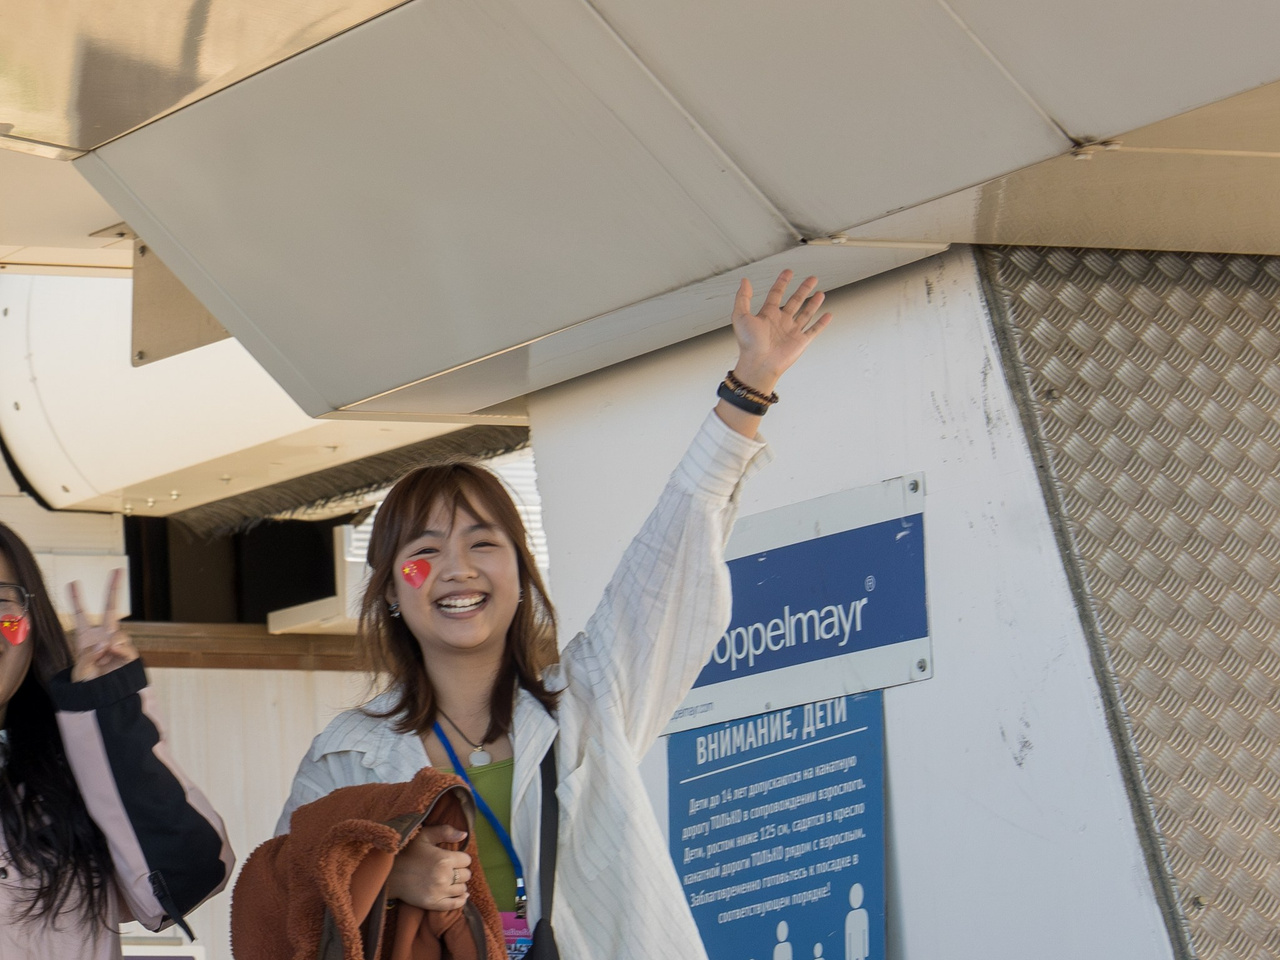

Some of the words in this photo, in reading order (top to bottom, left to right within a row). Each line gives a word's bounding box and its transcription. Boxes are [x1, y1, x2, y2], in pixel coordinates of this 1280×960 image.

[705, 597, 868, 672] oppelmayr
[696, 708, 797, 766] ВНИМАНИЕ,
[802, 696, 848, 740] ДЕТИ
[688, 798, 709, 816] Дети
[709, 795, 721, 810] до
[721, 788, 732, 804] 14
[733, 786, 748, 801] лет
[803, 767, 814, 781] на
[815, 755, 858, 777] канатную
[681, 821, 710, 841] дорогу
[710, 808, 742, 830] ТОЛЬКО
[706, 838, 735, 859] ростом
[735, 831, 759, 848] ниже
[760, 823, 776, 841] 125
[833, 802, 865, 823] кресло
[683, 862, 720, 886] канатной
[751, 845, 784, 867] ТОЛЬКО
[784, 841, 812, 862] рядом
[816, 855, 852, 874] посадке
